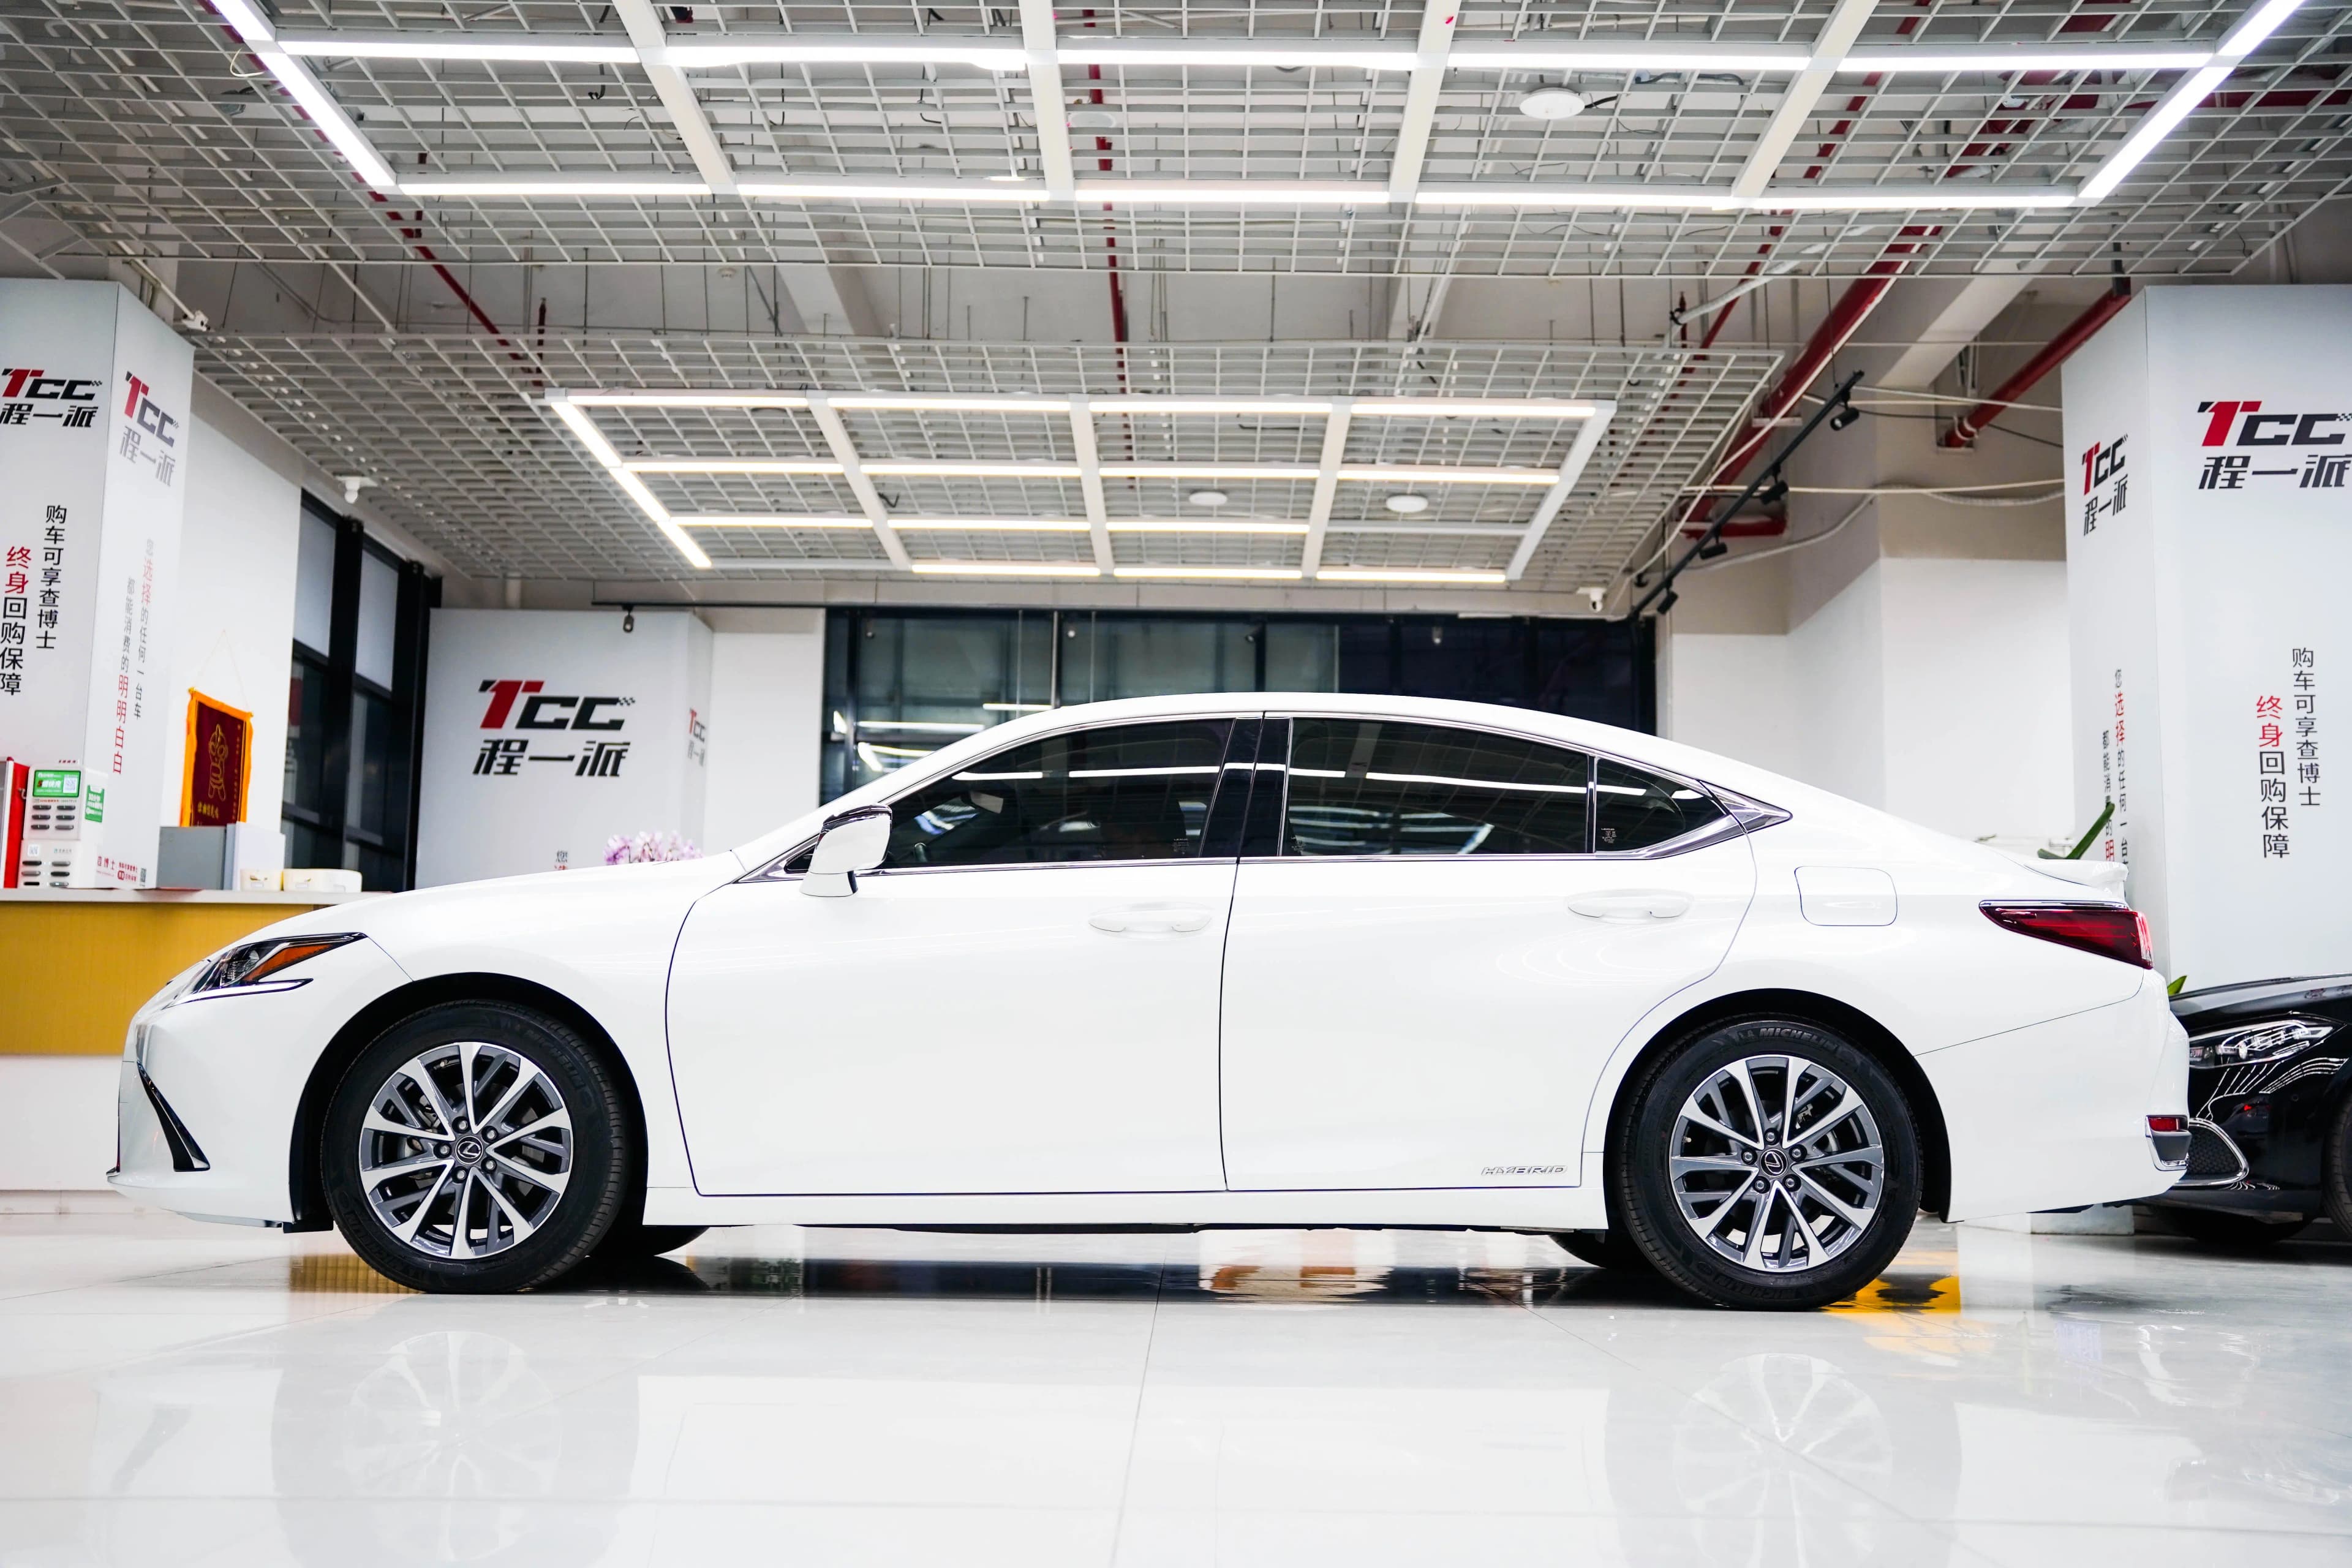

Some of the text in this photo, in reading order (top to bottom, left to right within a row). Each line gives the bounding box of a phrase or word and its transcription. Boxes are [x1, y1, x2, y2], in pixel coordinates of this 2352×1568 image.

[0, 403, 99, 428] 程一派
[2, 368, 102, 401] TCC
[125, 371, 179, 448] TCC
[2197, 401, 2352, 447] TCC
[120, 425, 176, 487] 程一派
[2082, 434, 2128, 496] TCC
[2198, 454, 2352, 489] 程一派
[2084, 473, 2128, 537] 程一派
[36, 505, 67, 650] 购车可享查博士
[0, 546, 32, 696] 终身回购保障
[478, 679, 635, 731] TCC
[2292, 647, 2321, 807] 购车可享查博士
[472, 739, 630, 777] 程一派
[2256, 695, 2290, 858] 终身回购保障
[1759, 1028, 1839, 1052] MICHELIN
